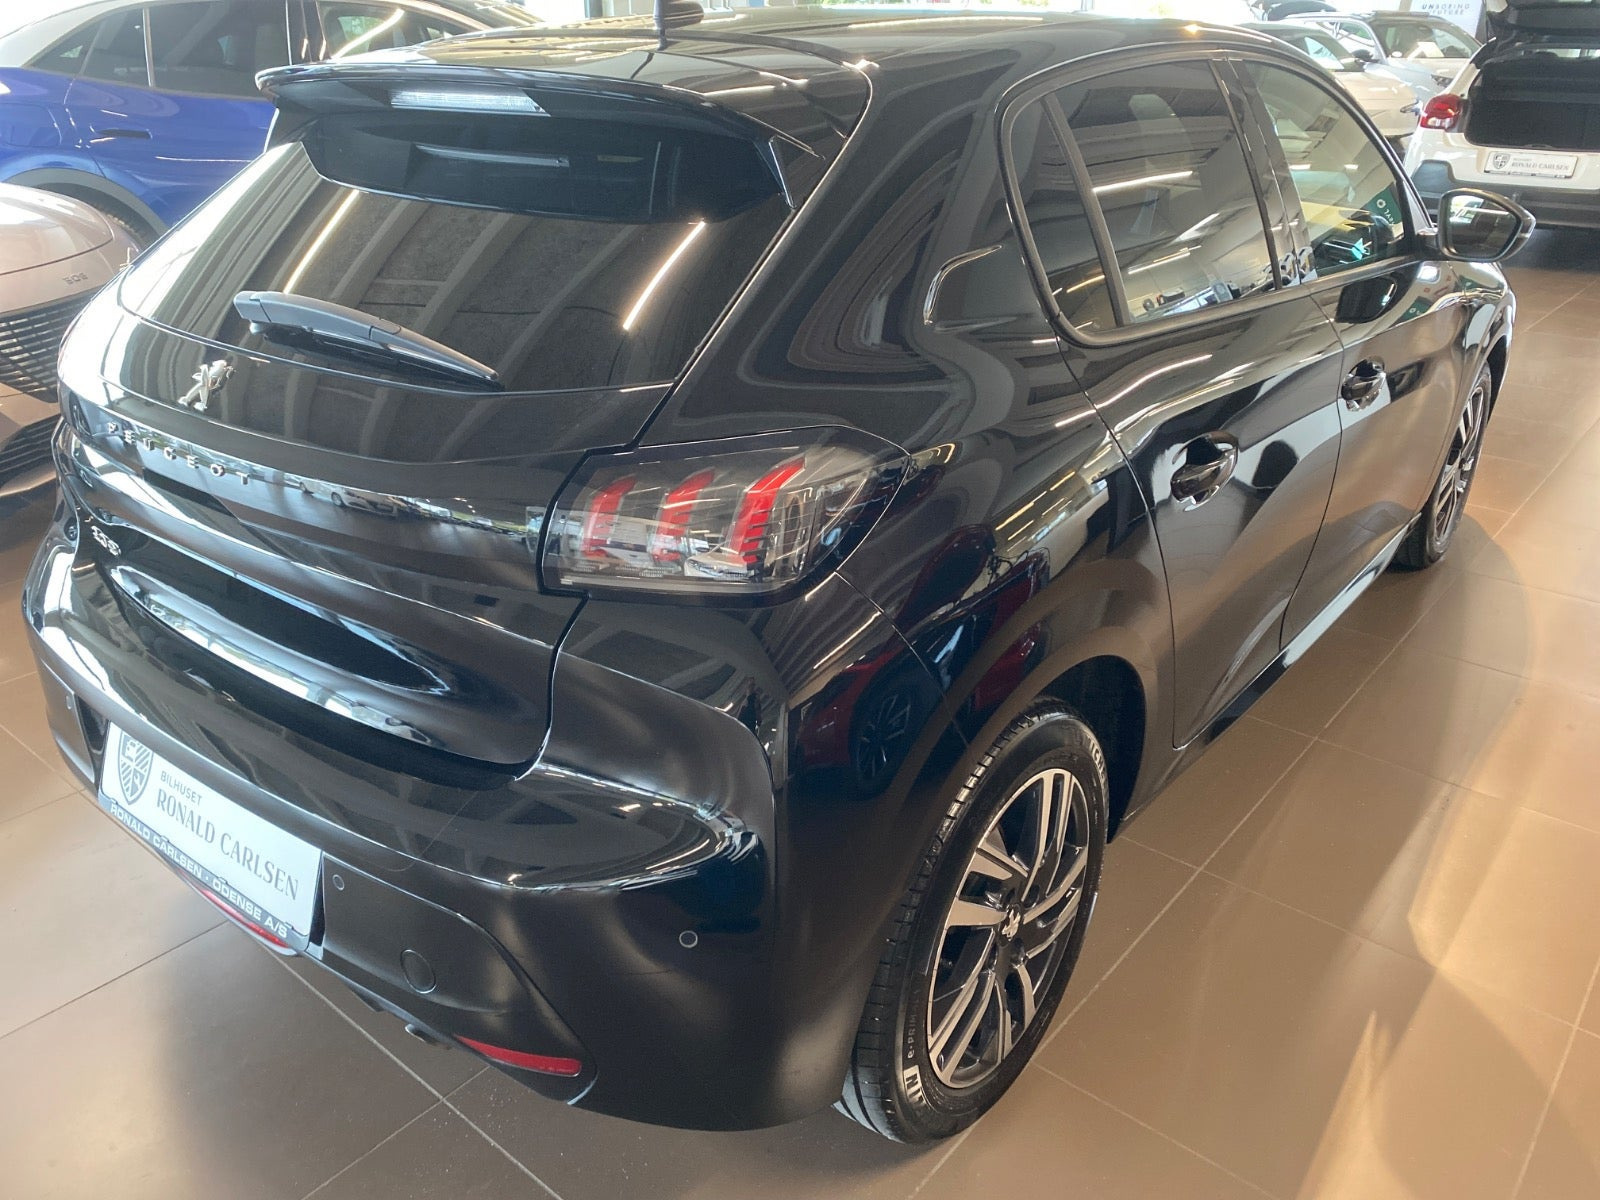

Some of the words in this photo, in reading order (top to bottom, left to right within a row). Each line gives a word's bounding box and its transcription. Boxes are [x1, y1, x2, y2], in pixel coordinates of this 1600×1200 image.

[108, 421, 250, 486] PEUGEOT
[160, 770, 203, 807] BILHUSET
[110, 802, 150, 839] RONALD
[152, 835, 202, 880] CARLSEN
[212, 877, 262, 921] ODENSE
[264, 915, 288, 938] A/S
[156, 788, 216, 844] RONALD
[220, 832, 299, 901] CARLSEN
